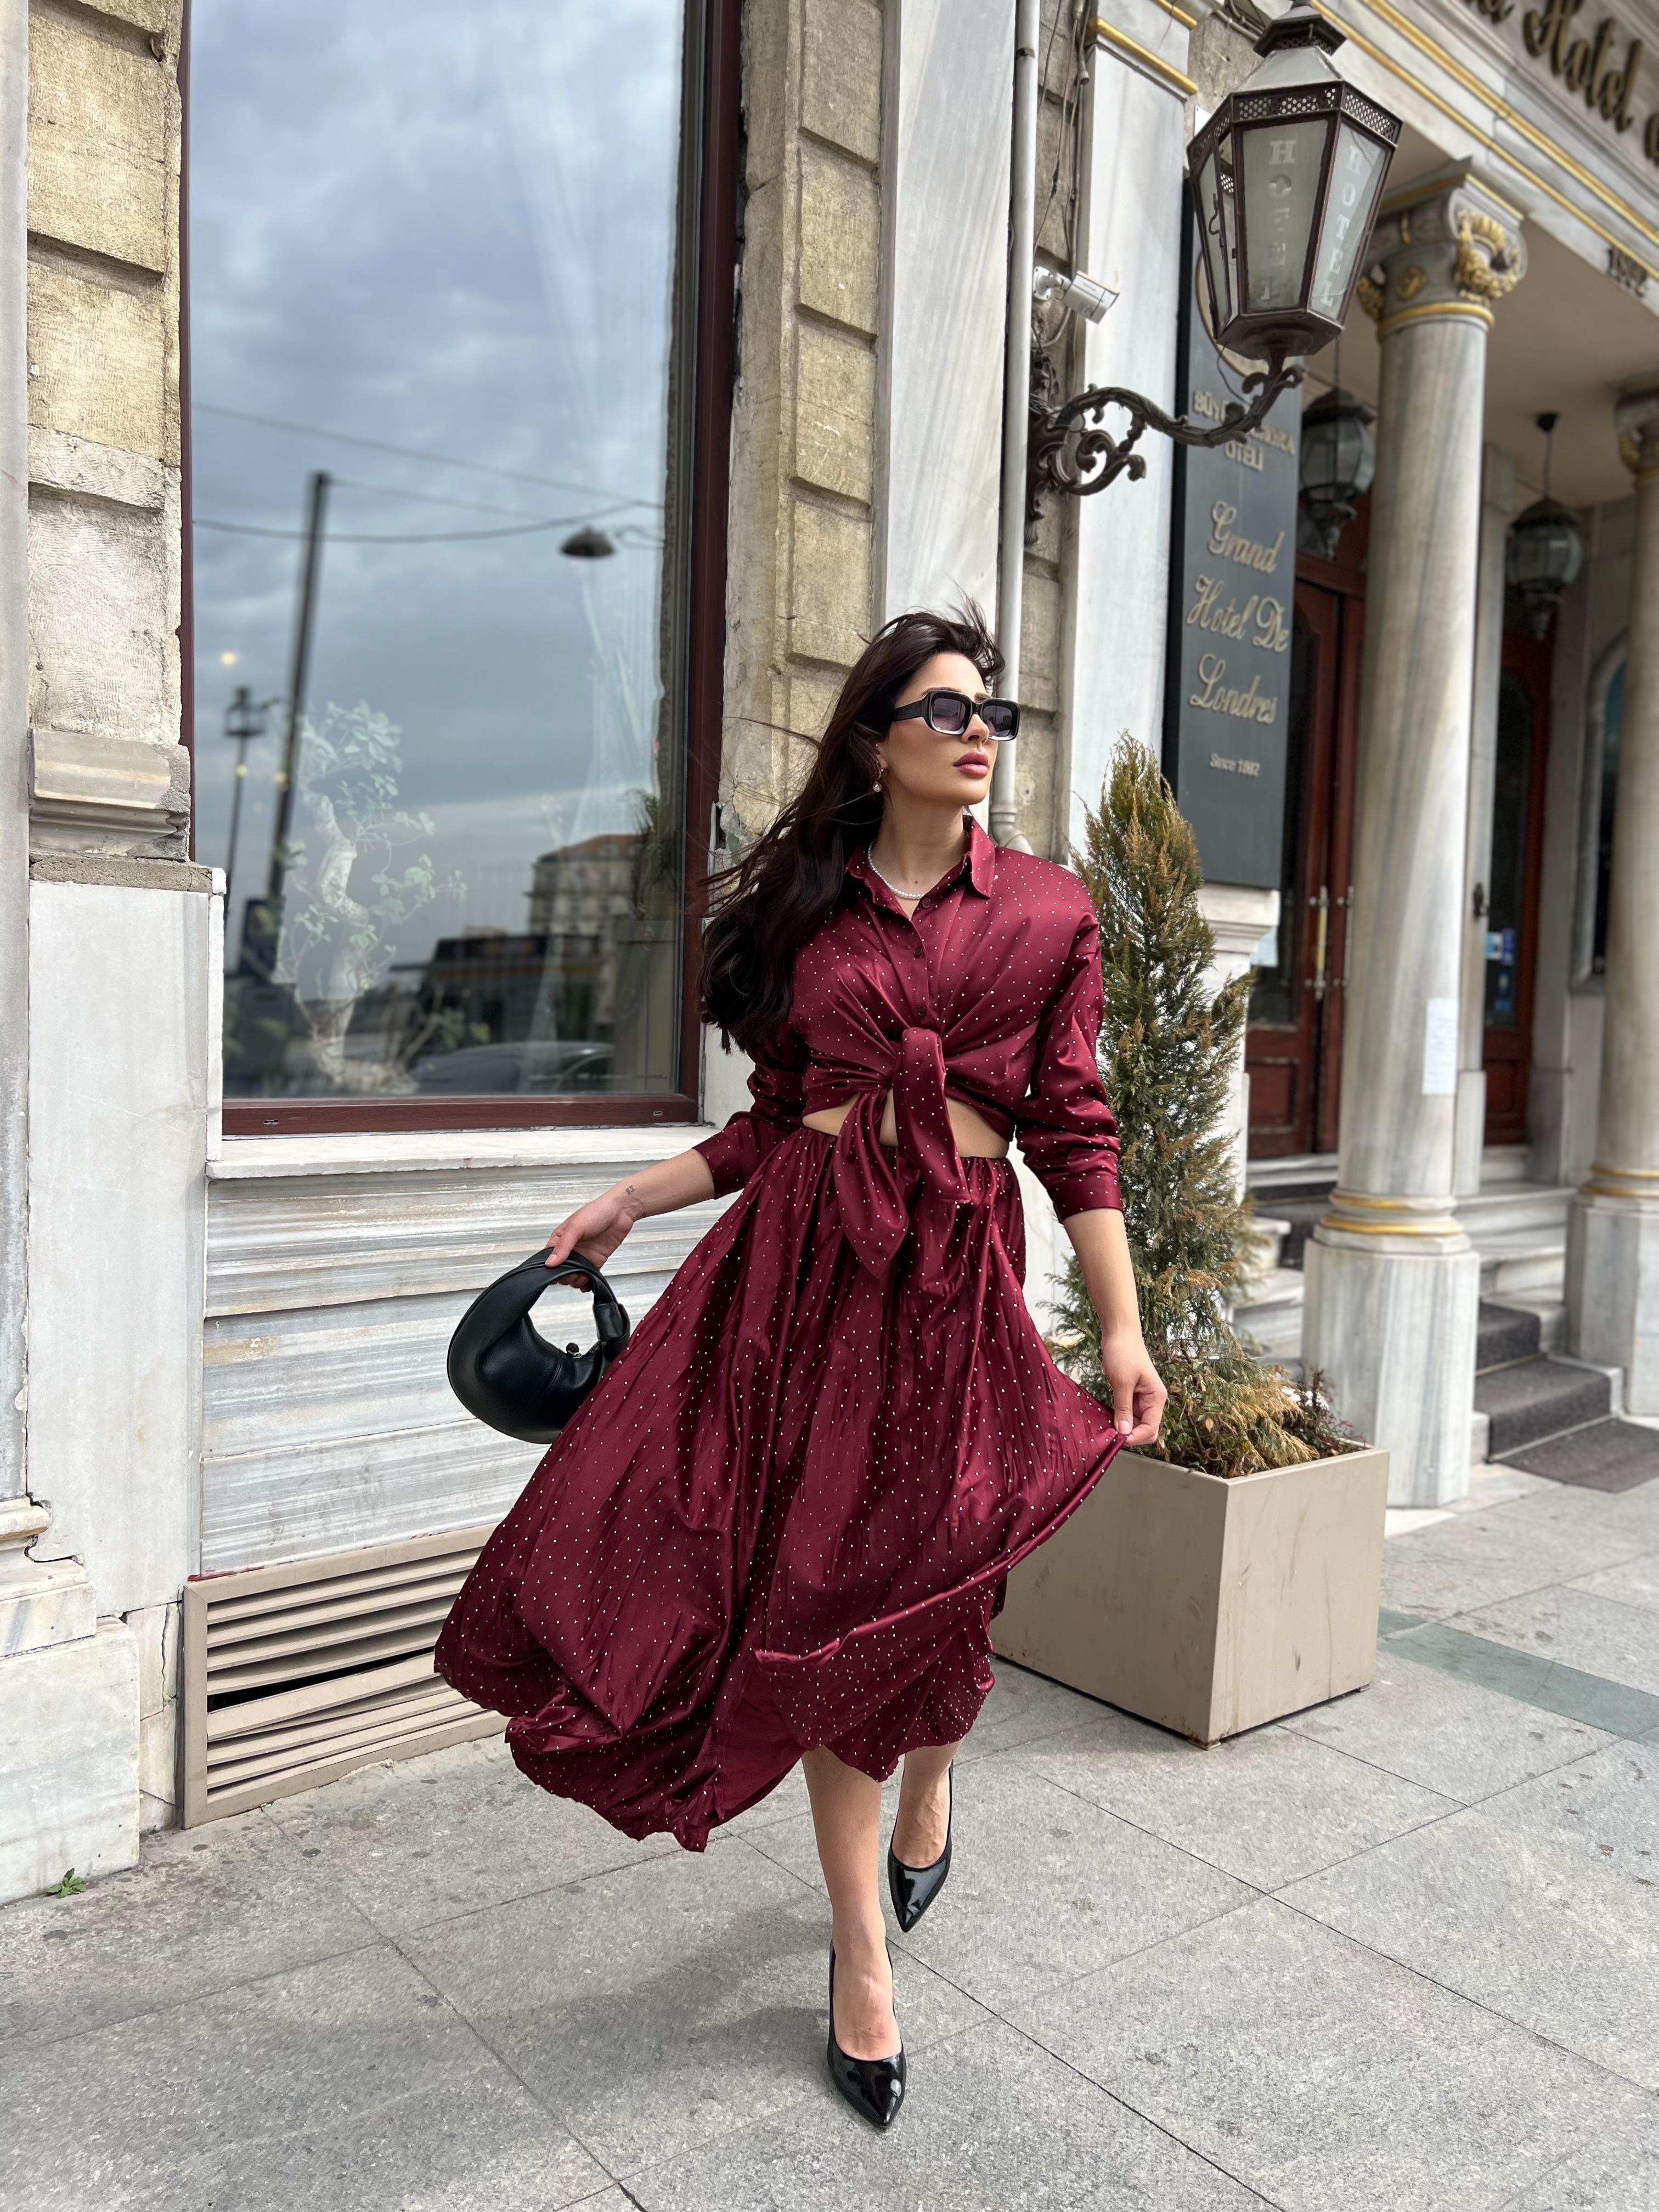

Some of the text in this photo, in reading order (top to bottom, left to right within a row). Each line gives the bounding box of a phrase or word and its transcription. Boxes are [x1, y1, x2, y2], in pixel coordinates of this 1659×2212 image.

[1320, 145, 1363, 308] HOTEL
[1209, 500, 1285, 573] Grand
[1187, 574, 1289, 652] Hotel De
[1188, 653, 1277, 724] Londres
[1210, 753, 1235, 771] Since
